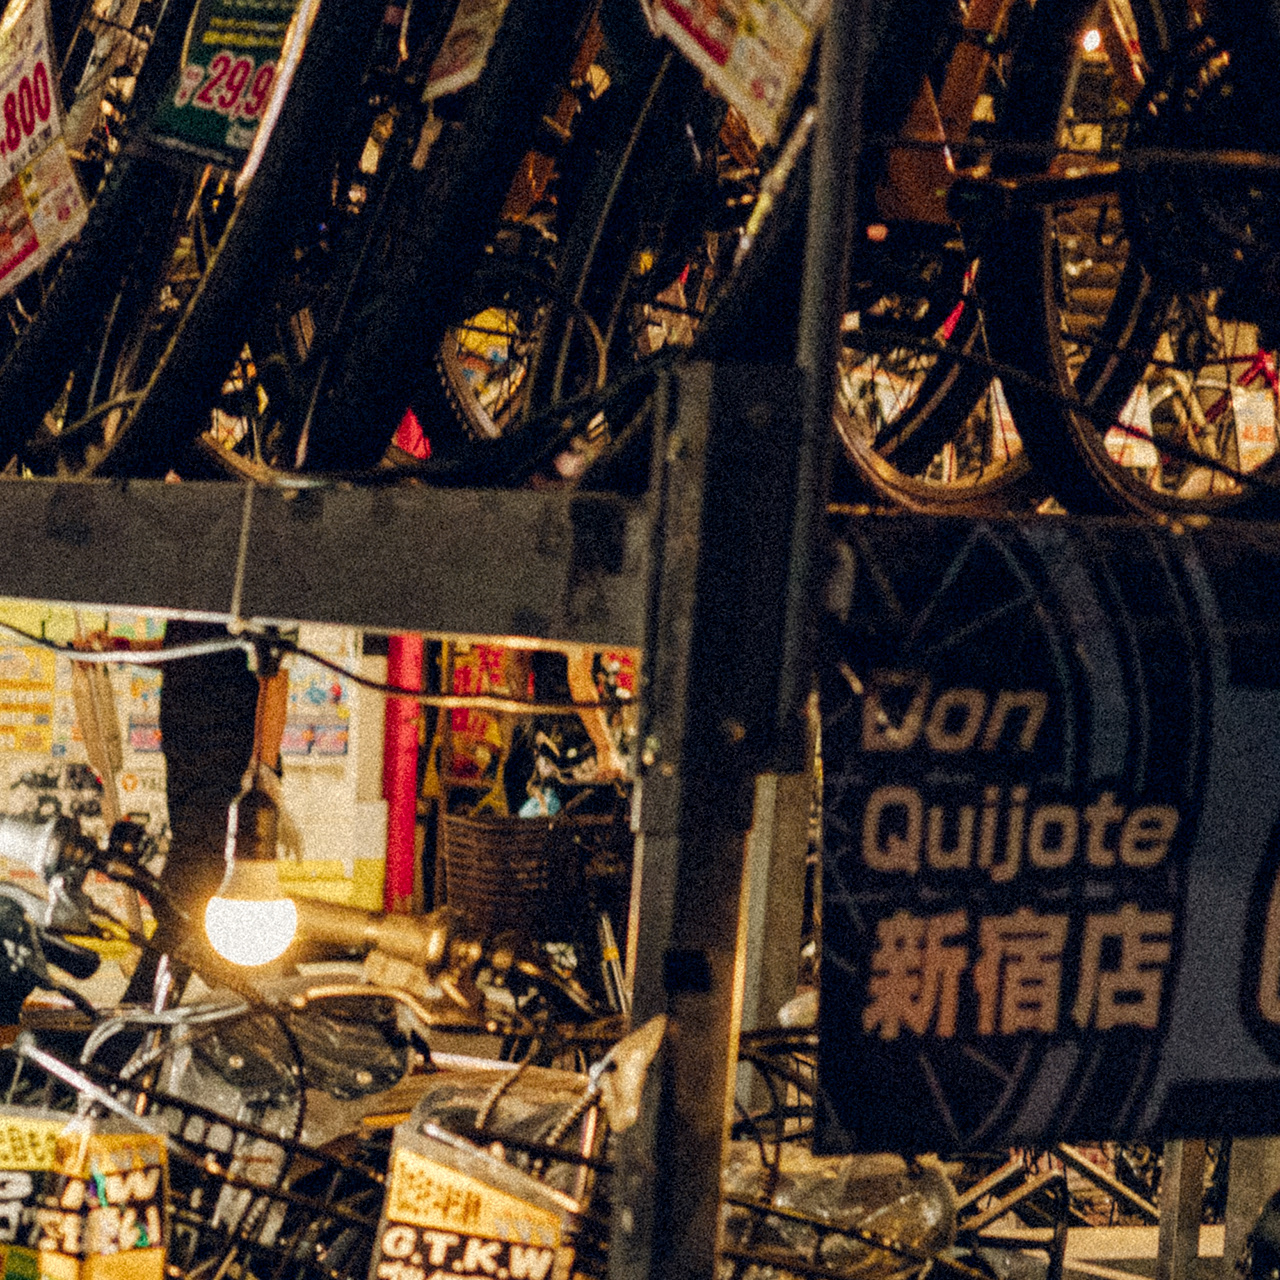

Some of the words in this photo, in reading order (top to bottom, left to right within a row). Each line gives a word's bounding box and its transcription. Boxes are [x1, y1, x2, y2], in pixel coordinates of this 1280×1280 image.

[860, 669, 1048, 752] Don
[861, 785, 1180, 882] Quijote
[861, 903, 1174, 1040] 新宿店
